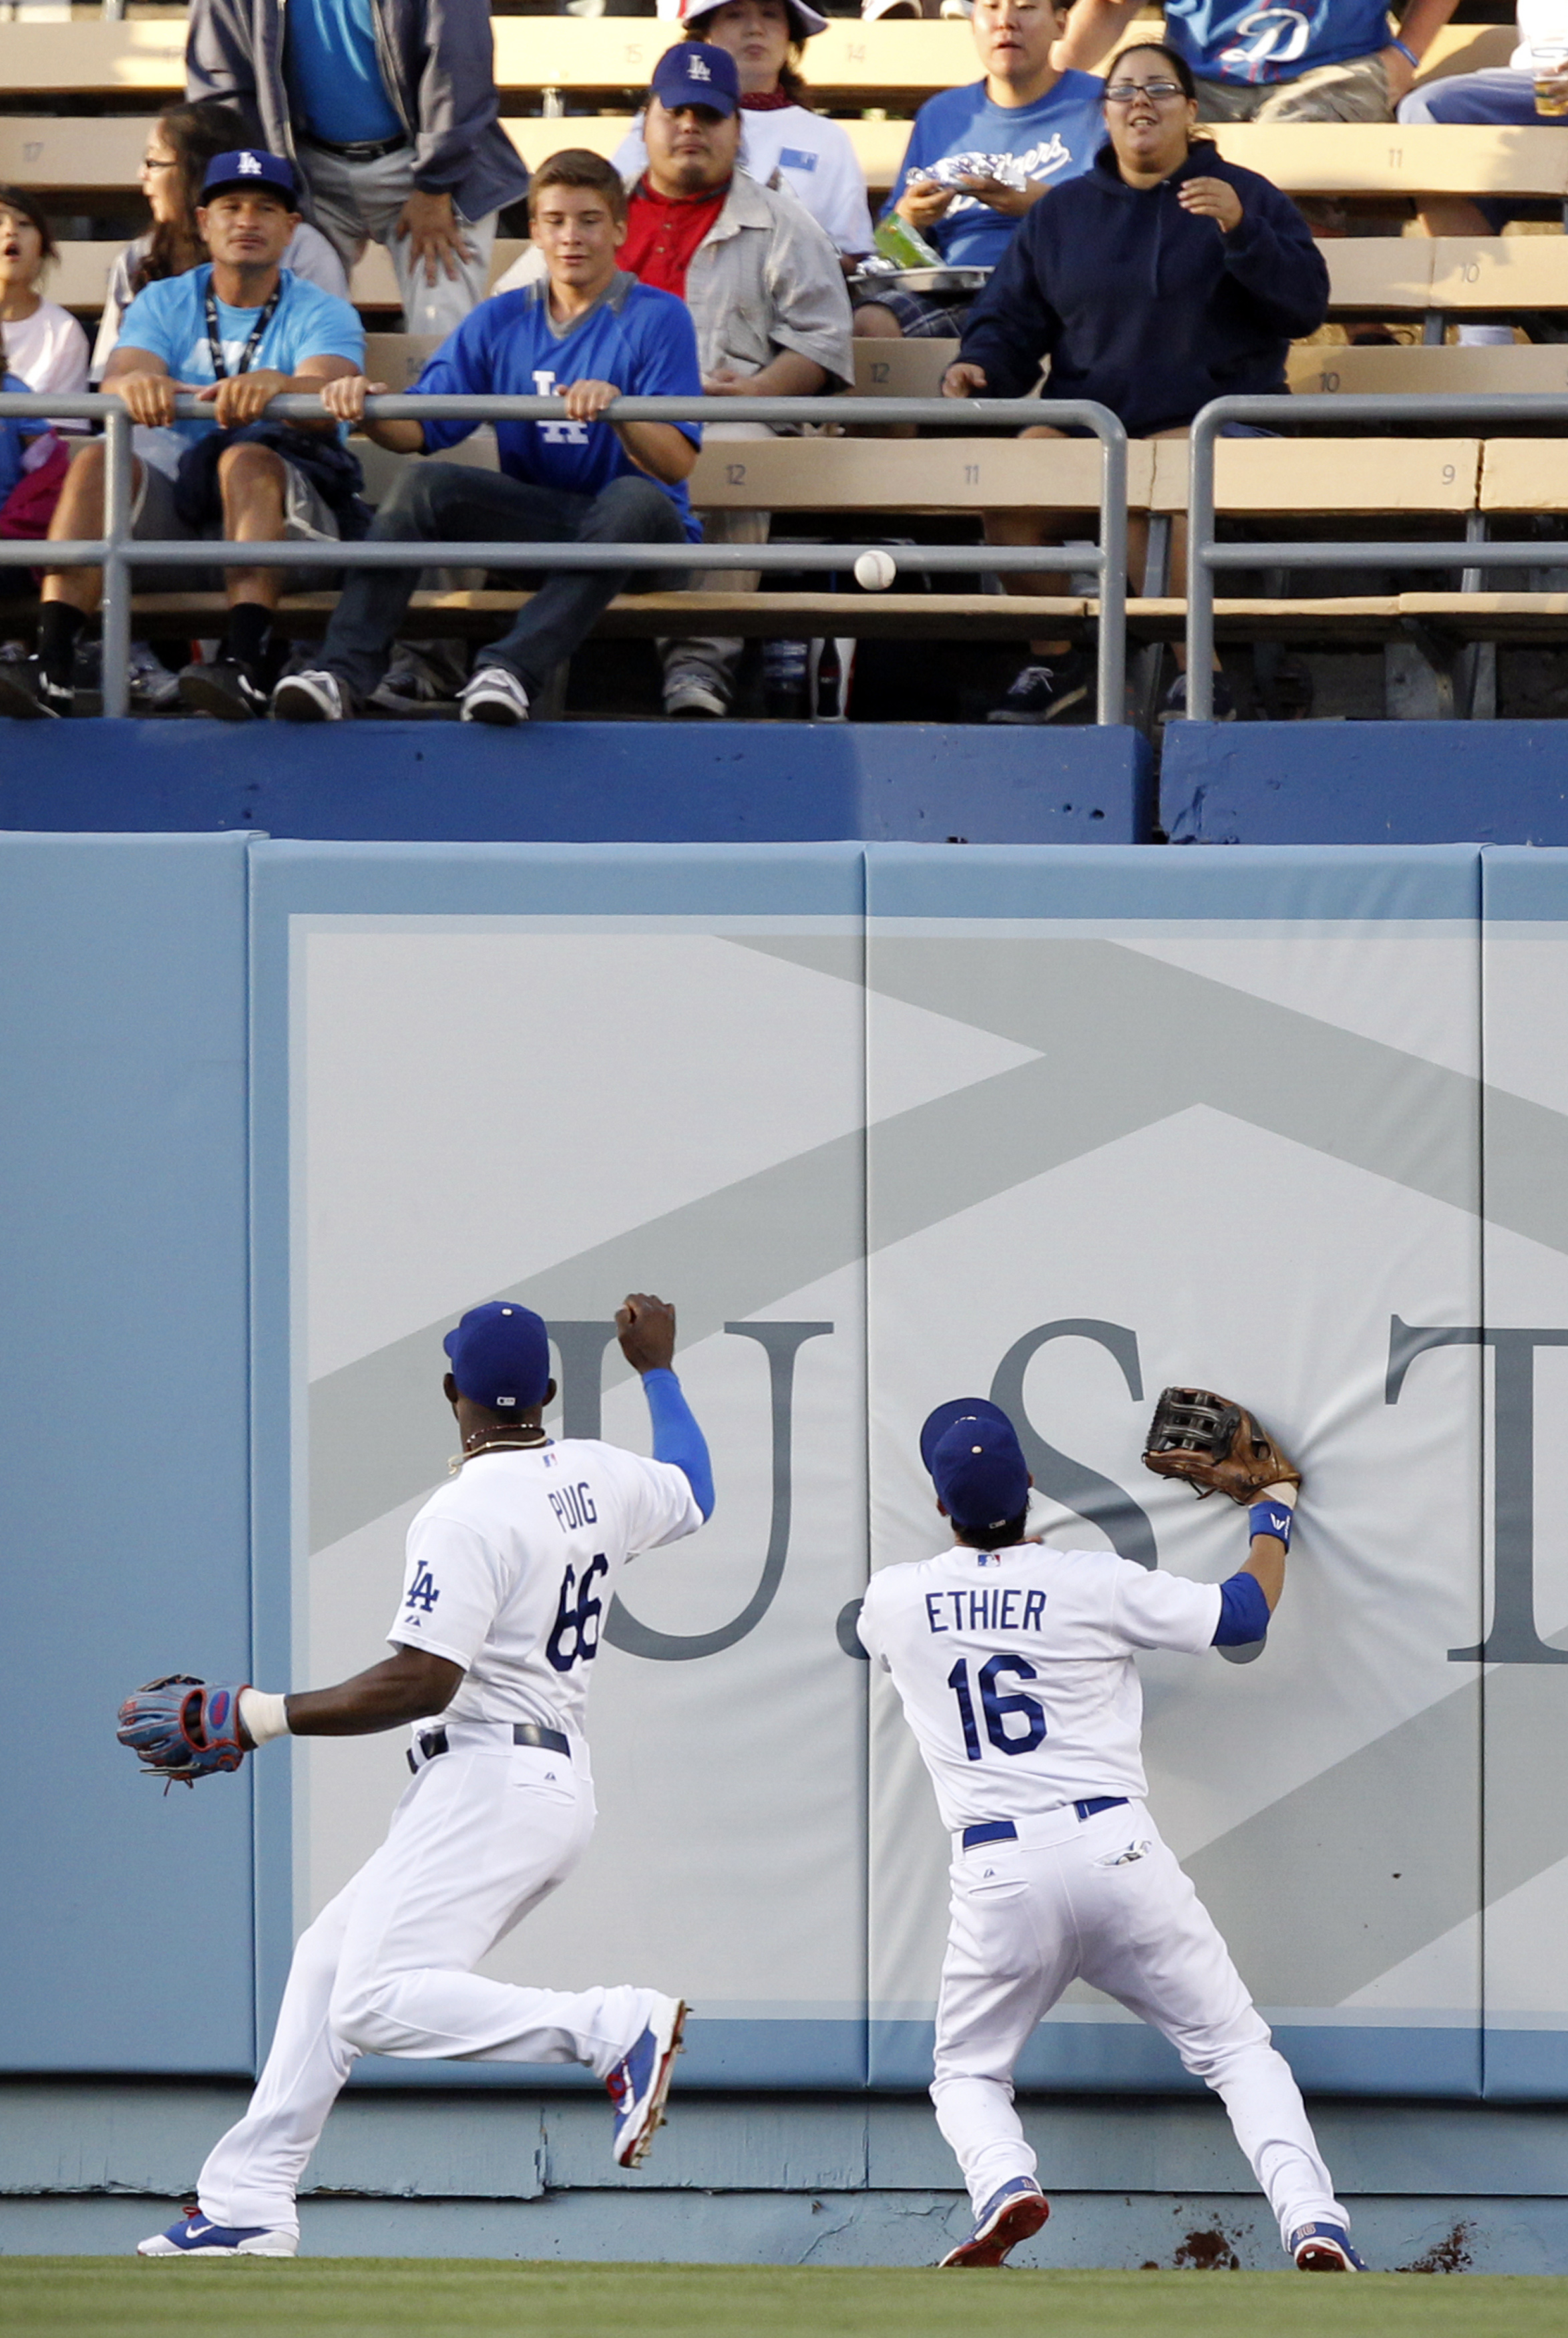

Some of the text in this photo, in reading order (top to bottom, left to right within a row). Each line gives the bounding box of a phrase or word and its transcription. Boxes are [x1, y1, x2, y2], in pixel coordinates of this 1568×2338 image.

[1219, 7, 1310, 63] D
[687, 54, 712, 81] LA
[237, 151, 263, 175] LA
[1388, 148, 1403, 168] 11
[1460, 263, 1480, 283] 10
[870, 363, 890, 383] 12
[1319, 371, 1340, 392] 10
[726, 464, 746, 485] 12
[964, 464, 980, 485] 11
[1442, 464, 1456, 486] 9
[548, 1482, 598, 1534] PUIG
[405, 1560, 440, 1613] LA
[546, 1552, 609, 1672] 66
[925, 1589, 1047, 1633] ETHIER
[947, 1654, 1048, 1761] 16
